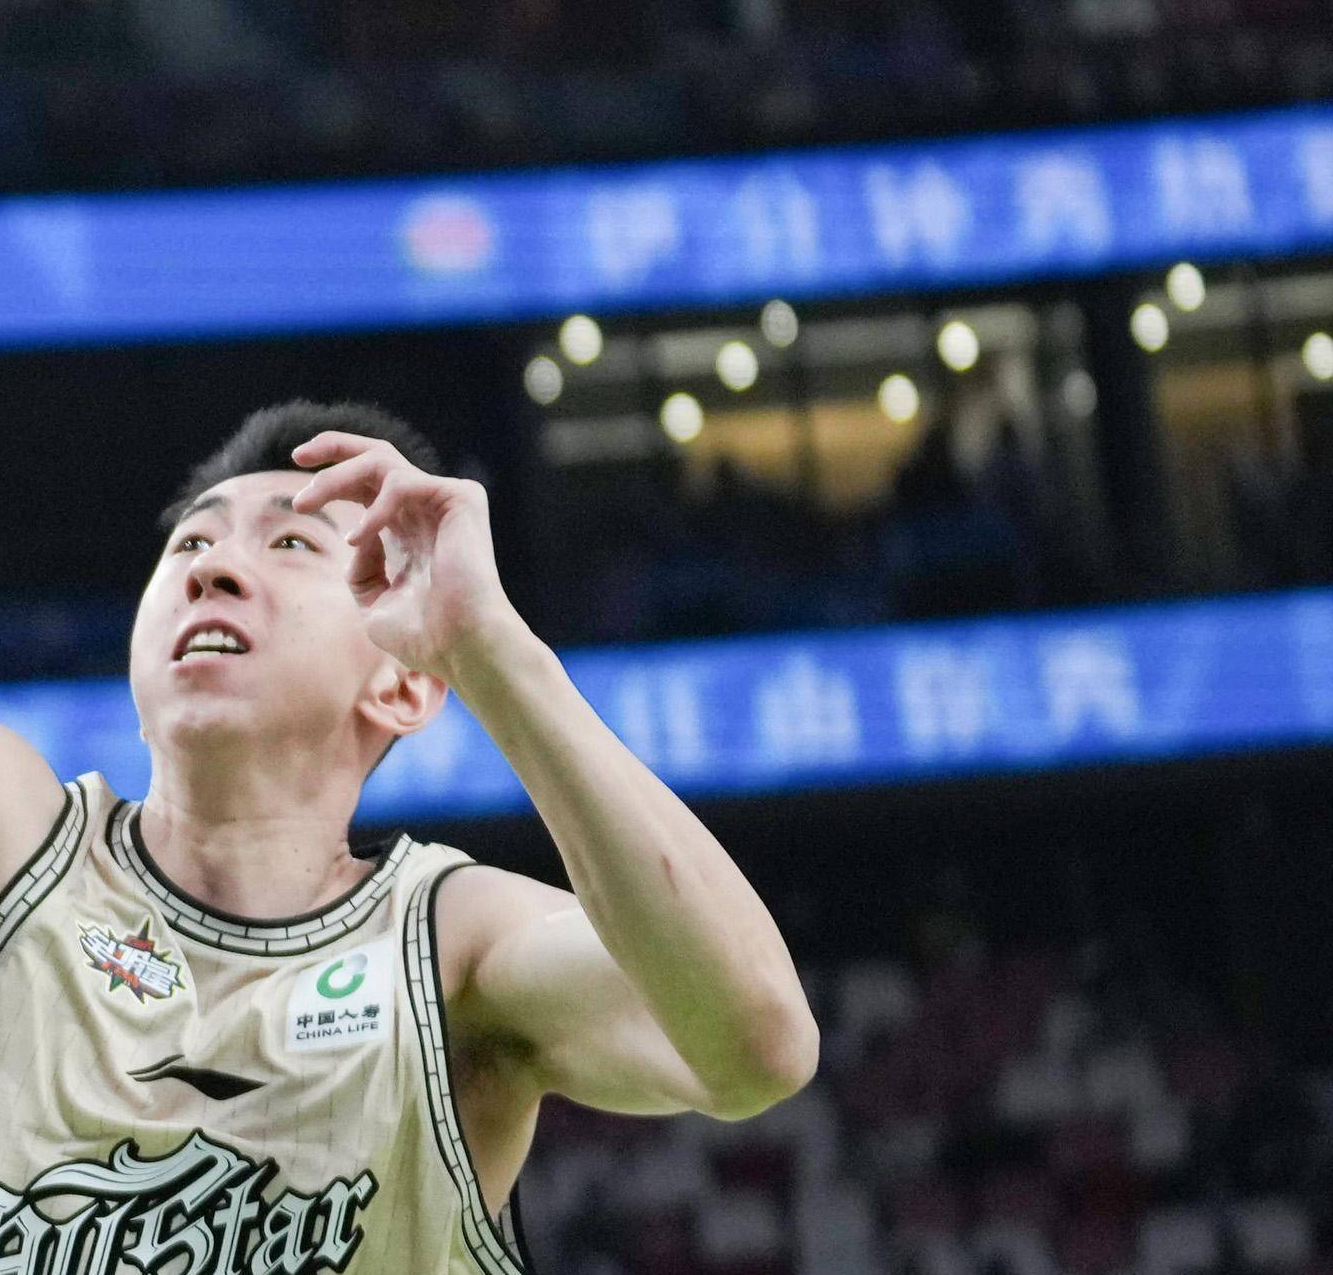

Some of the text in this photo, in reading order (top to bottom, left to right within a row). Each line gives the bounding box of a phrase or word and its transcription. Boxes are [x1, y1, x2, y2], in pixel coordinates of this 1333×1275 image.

[296, 1004, 380, 1028] 中国人寿
[296, 1021, 380, 1040] CHINA LIFE
